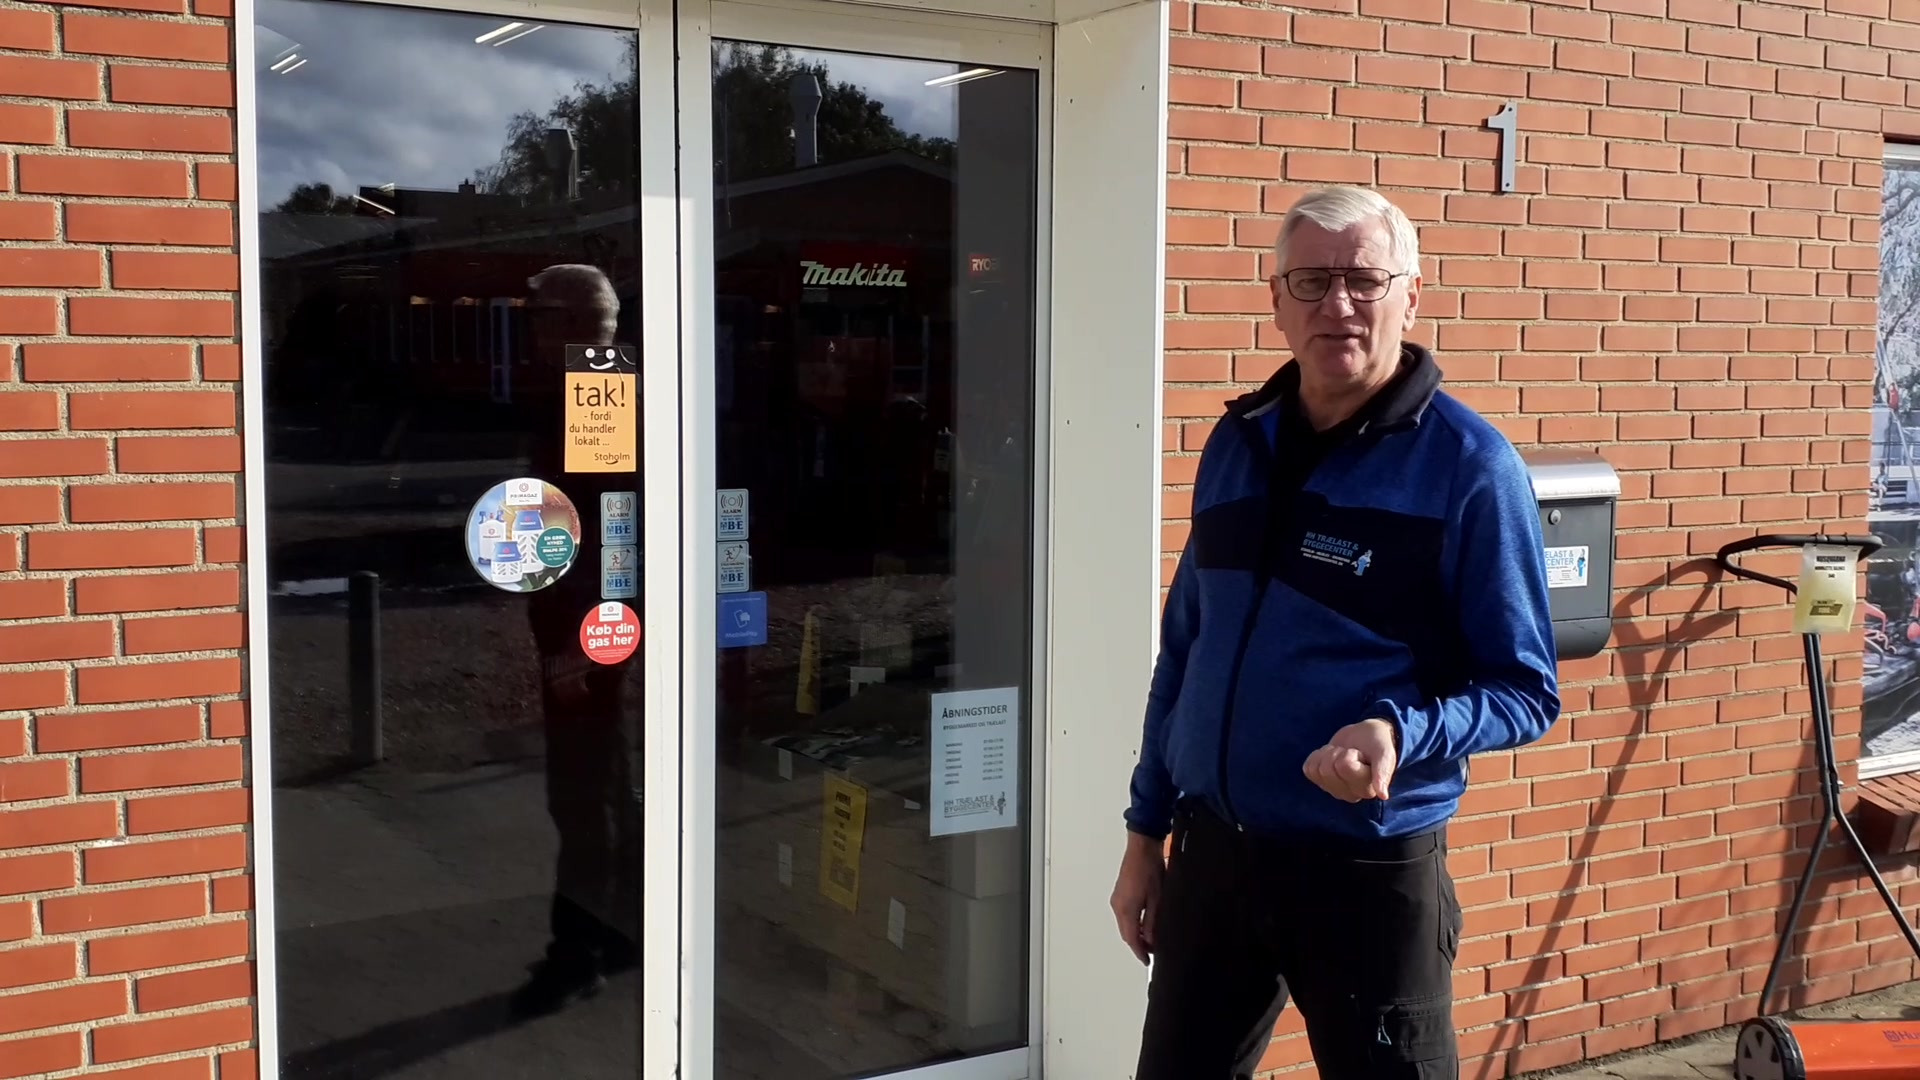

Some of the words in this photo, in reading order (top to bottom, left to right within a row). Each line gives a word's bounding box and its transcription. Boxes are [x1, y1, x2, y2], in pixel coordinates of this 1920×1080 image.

[1488, 101, 1517, 192] 1
[573, 378, 625, 407] tak!
[590, 410, 612, 421] fordi
[568, 423, 580, 433] du
[582, 423, 617, 433] handler
[574, 436, 600, 446] lokalt
[594, 452, 630, 461] Stoholm
[1303, 539, 1354, 557] BYGGECENTER
[1546, 557, 1574, 566] CENTER
[586, 623, 613, 636] Køb
[615, 622, 635, 634] din
[587, 637, 610, 649] gas
[612, 634, 634, 646] her
[942, 704, 1008, 719] ÅBNINGSTIDER
